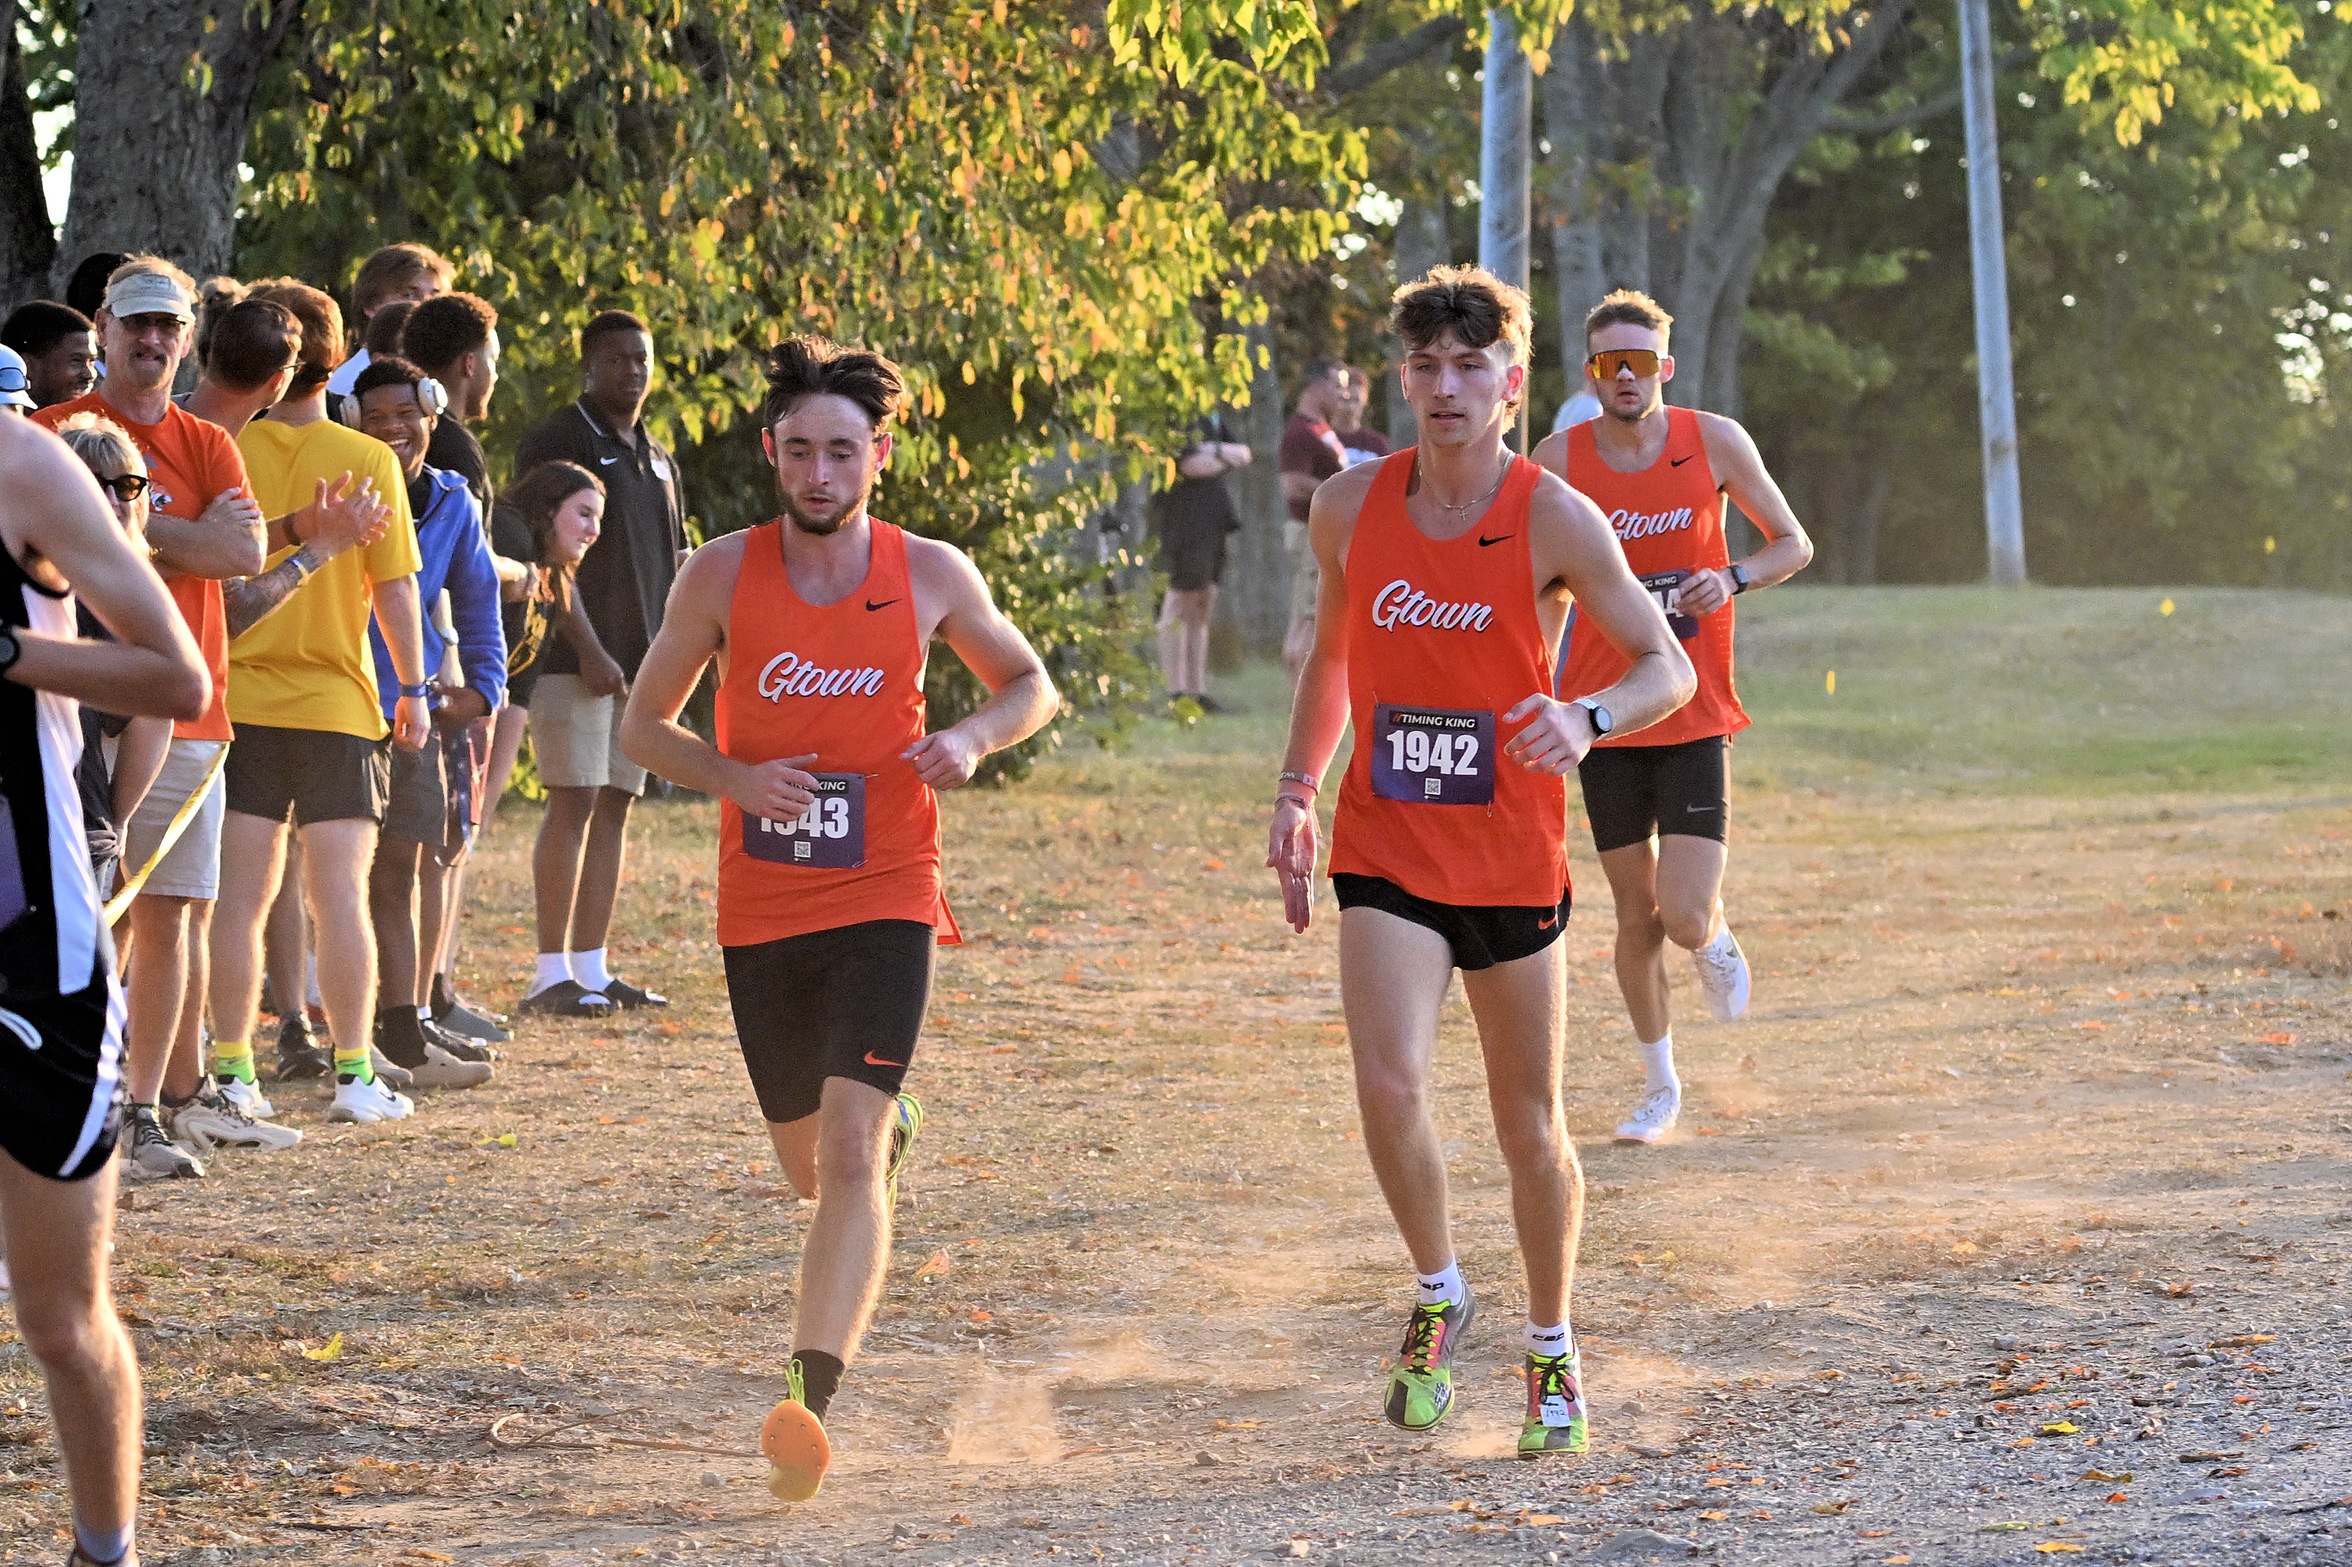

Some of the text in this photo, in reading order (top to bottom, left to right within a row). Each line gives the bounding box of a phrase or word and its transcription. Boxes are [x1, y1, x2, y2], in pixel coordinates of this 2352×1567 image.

[1608, 508, 1694, 541] Gtown
[1372, 579, 1494, 633] Gtown
[758, 651, 885, 704] Gtown
[1445, 717, 1476, 729] KING
[1386, 729, 1480, 776] 1942
